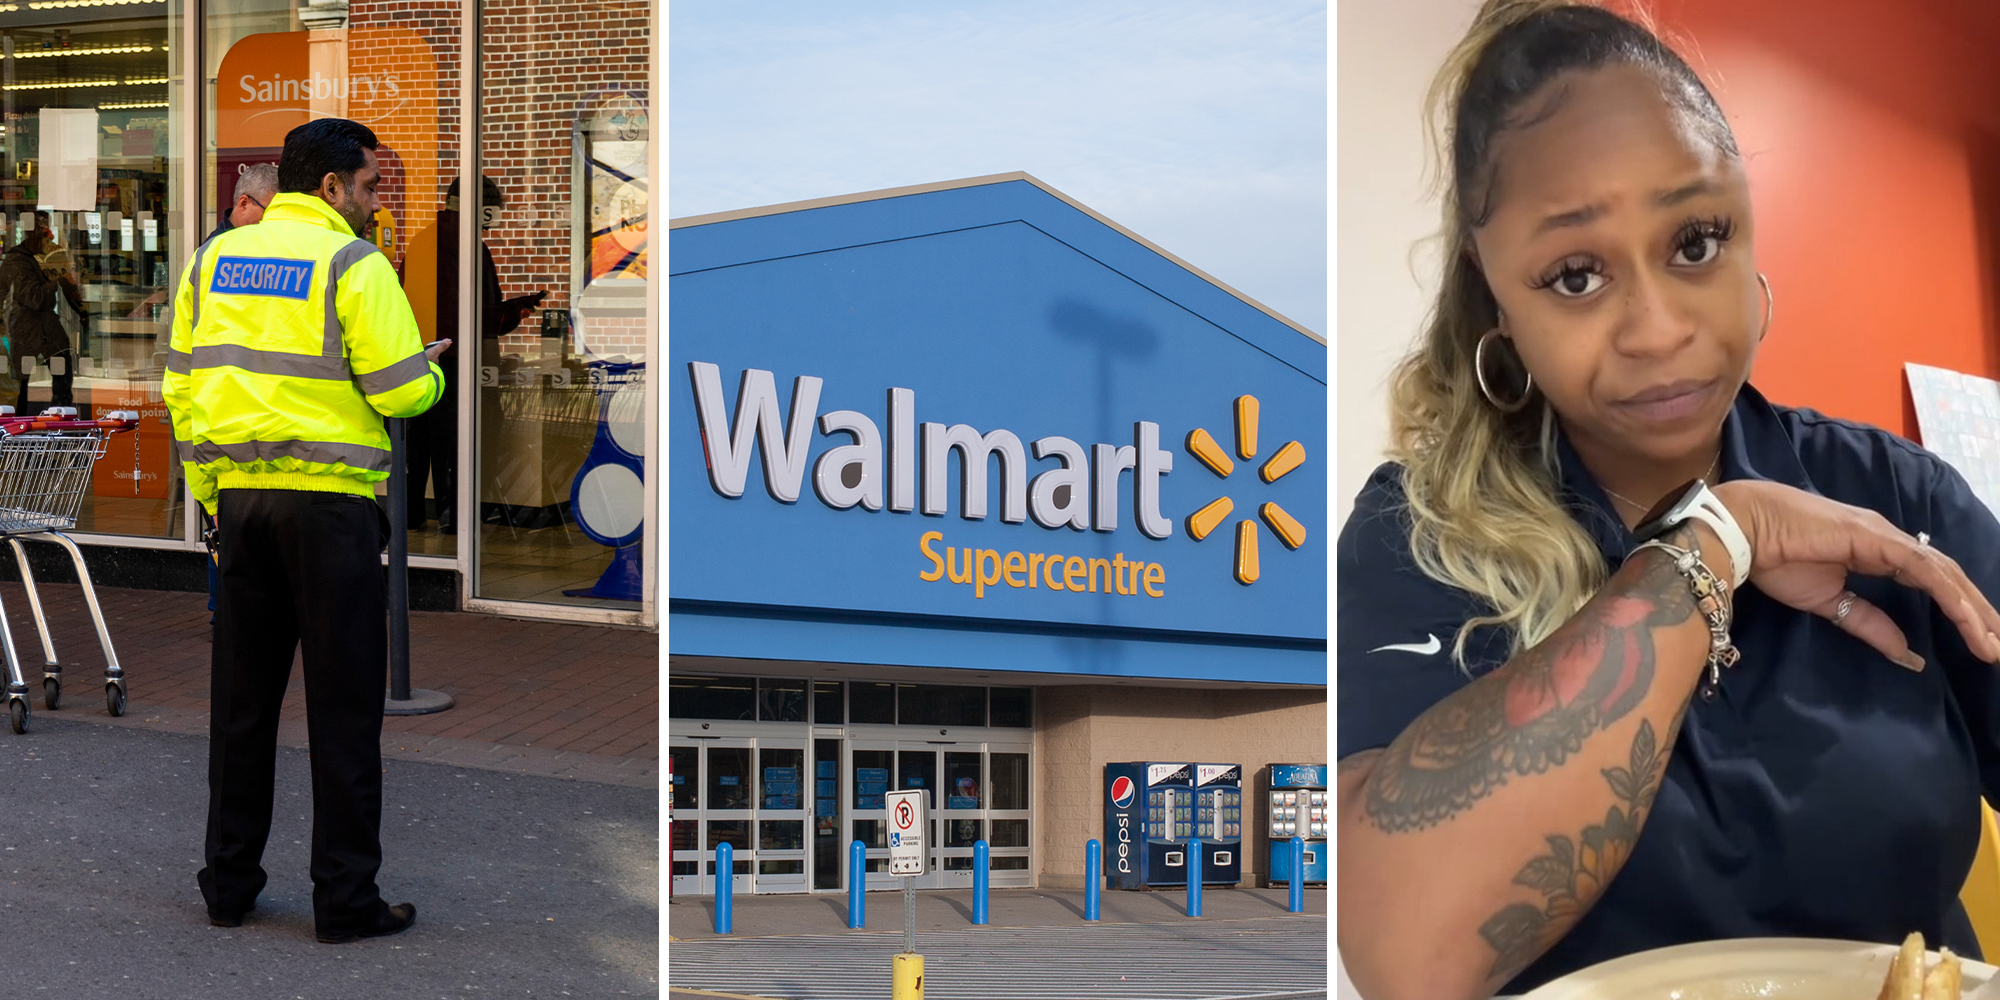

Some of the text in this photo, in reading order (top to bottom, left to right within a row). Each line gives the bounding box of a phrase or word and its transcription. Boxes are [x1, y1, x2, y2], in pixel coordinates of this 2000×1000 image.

[239, 68, 400, 105] Sainsbury's
[4, 111, 22, 121] Fizzy
[217, 262, 309, 292] SECURITY
[118, 397, 143, 407] Food
[688, 360, 1173, 540] Walmart
[113, 470, 157, 481] Sainsury's
[919, 531, 1166, 598] Supercentre
[901, 807, 909, 825] P
[1116, 813, 1131, 873] pepsi
